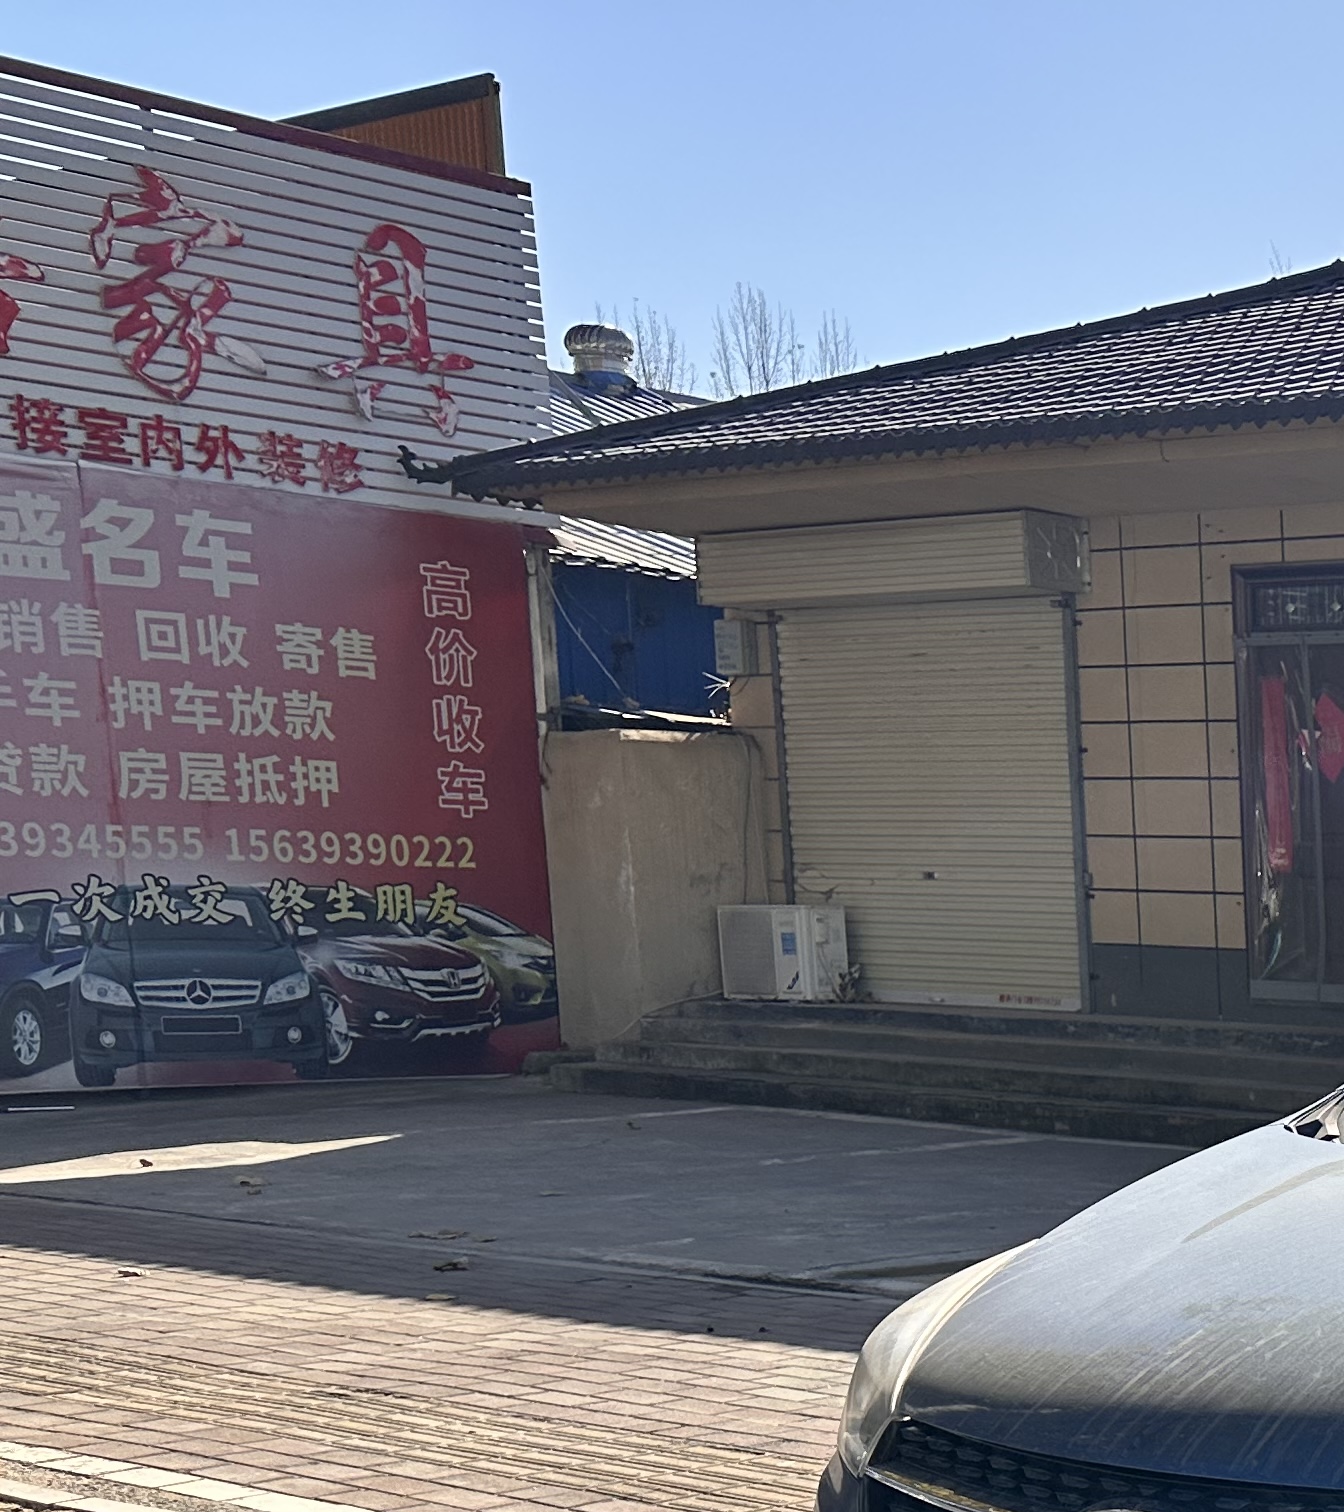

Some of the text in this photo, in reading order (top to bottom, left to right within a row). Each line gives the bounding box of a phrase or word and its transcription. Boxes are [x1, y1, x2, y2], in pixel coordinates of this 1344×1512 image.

[0, 165, 476, 438] 家具
[10, 394, 365, 494] 接室内外装修
[0, 490, 260, 598] 盛名车
[0, 599, 378, 681] 销售 回收 寄售
[108, 674, 336, 743] 押车放款
[418, 560, 489, 819] 高价收车
[118, 747, 341, 809] 房屋抵押
[225, 827, 478, 870] 15639390222
[7, 874, 470, 928] 一次成交 终生朋友
